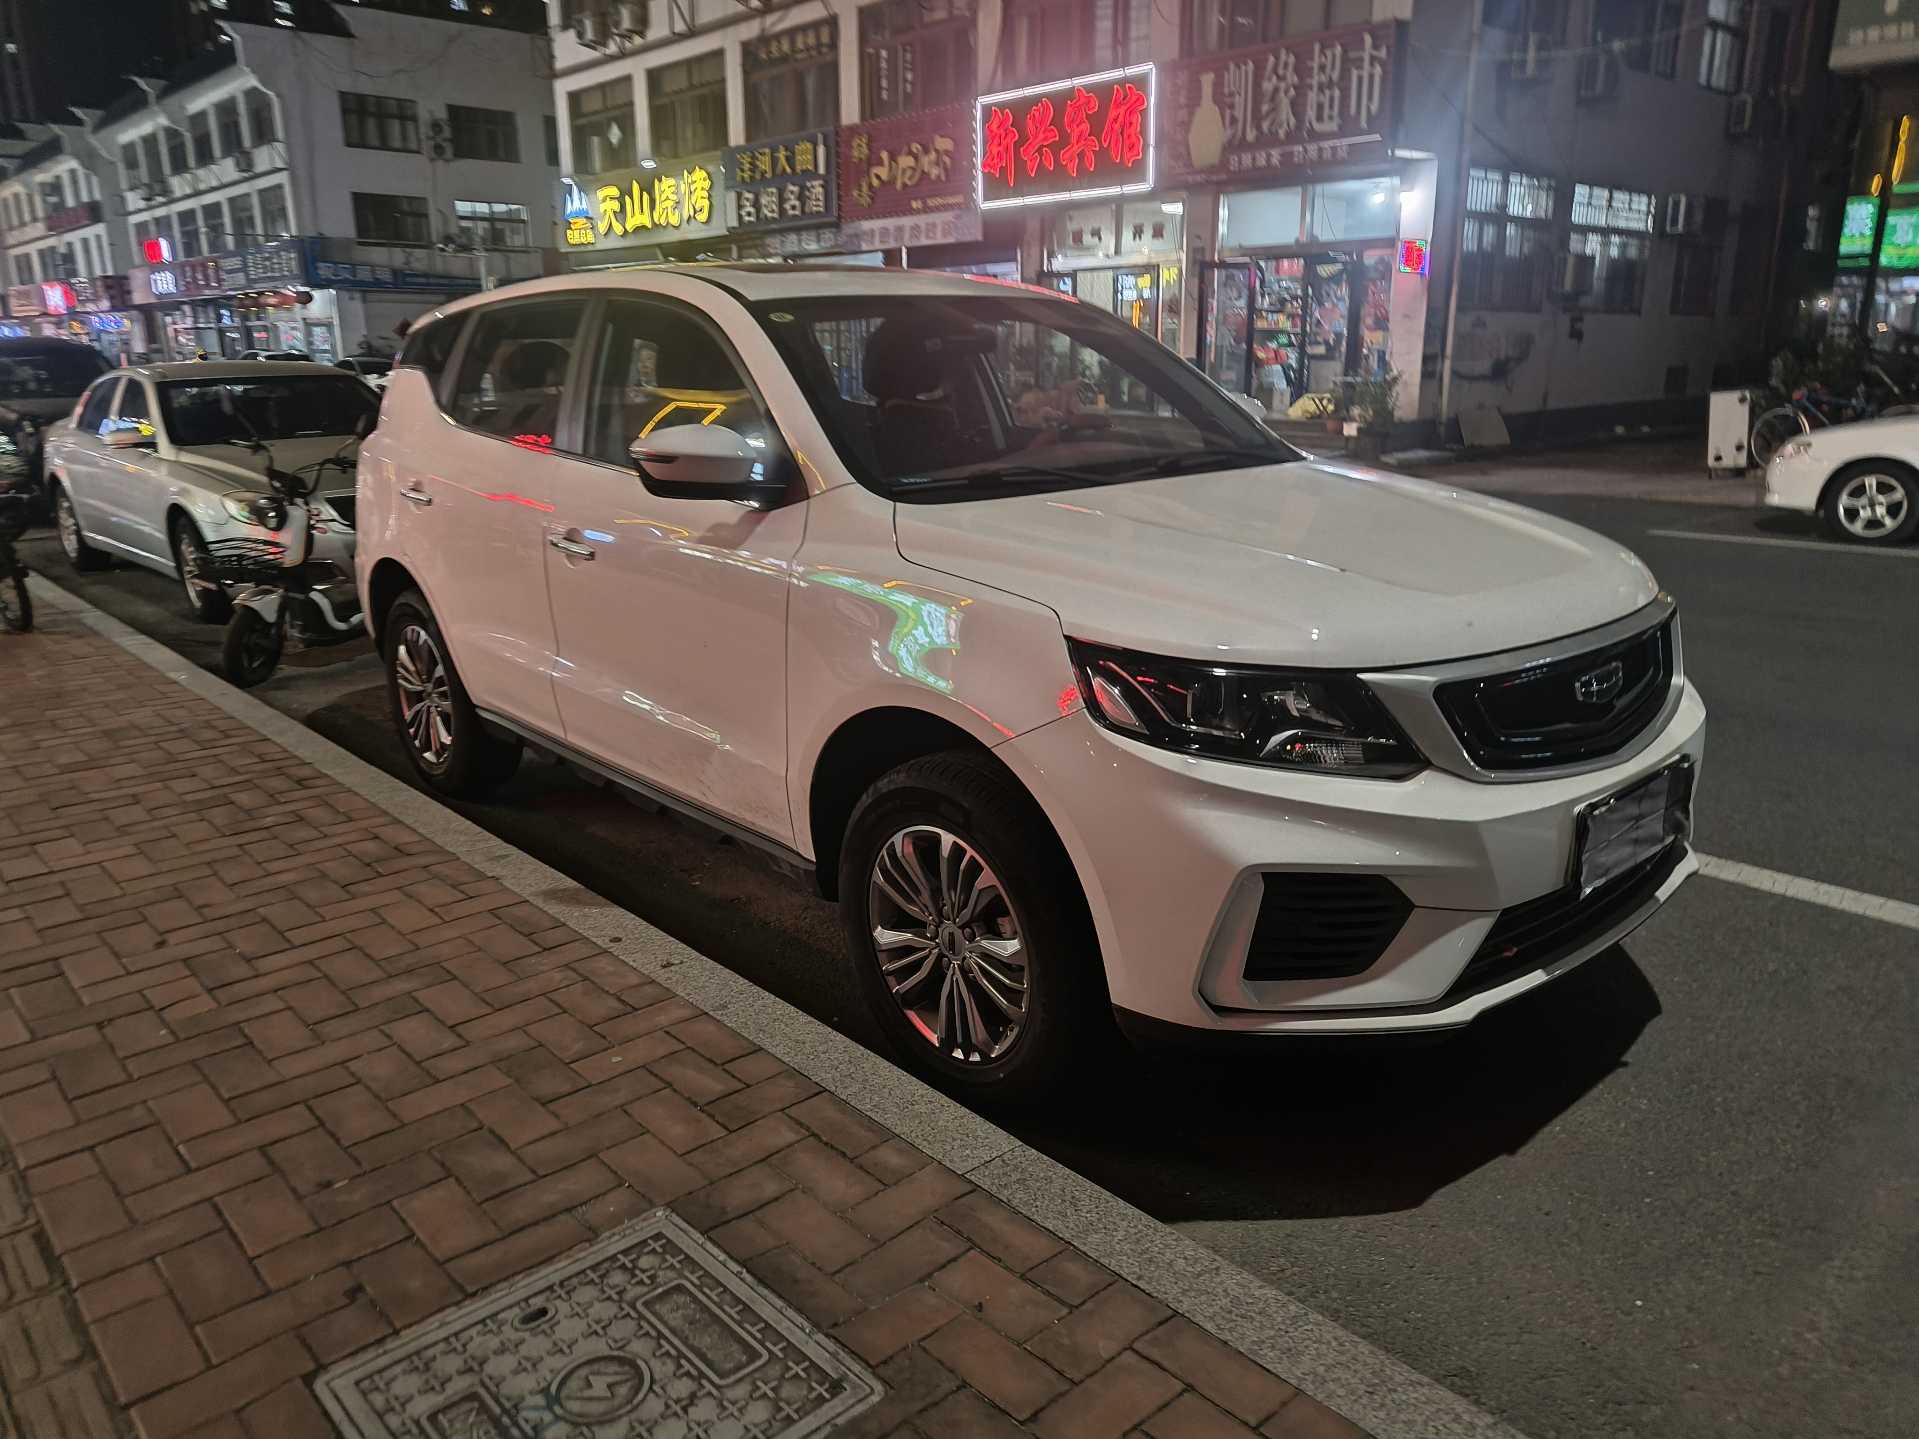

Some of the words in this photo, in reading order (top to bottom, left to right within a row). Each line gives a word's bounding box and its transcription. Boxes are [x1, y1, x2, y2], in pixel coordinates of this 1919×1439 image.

[1224, 32, 1387, 144] 凯缘超市
[982, 83, 1148, 187] 新兴宾馆
[596, 165, 711, 236] 天山烧烤
[739, 179, 826, 224] 名烟名酒
